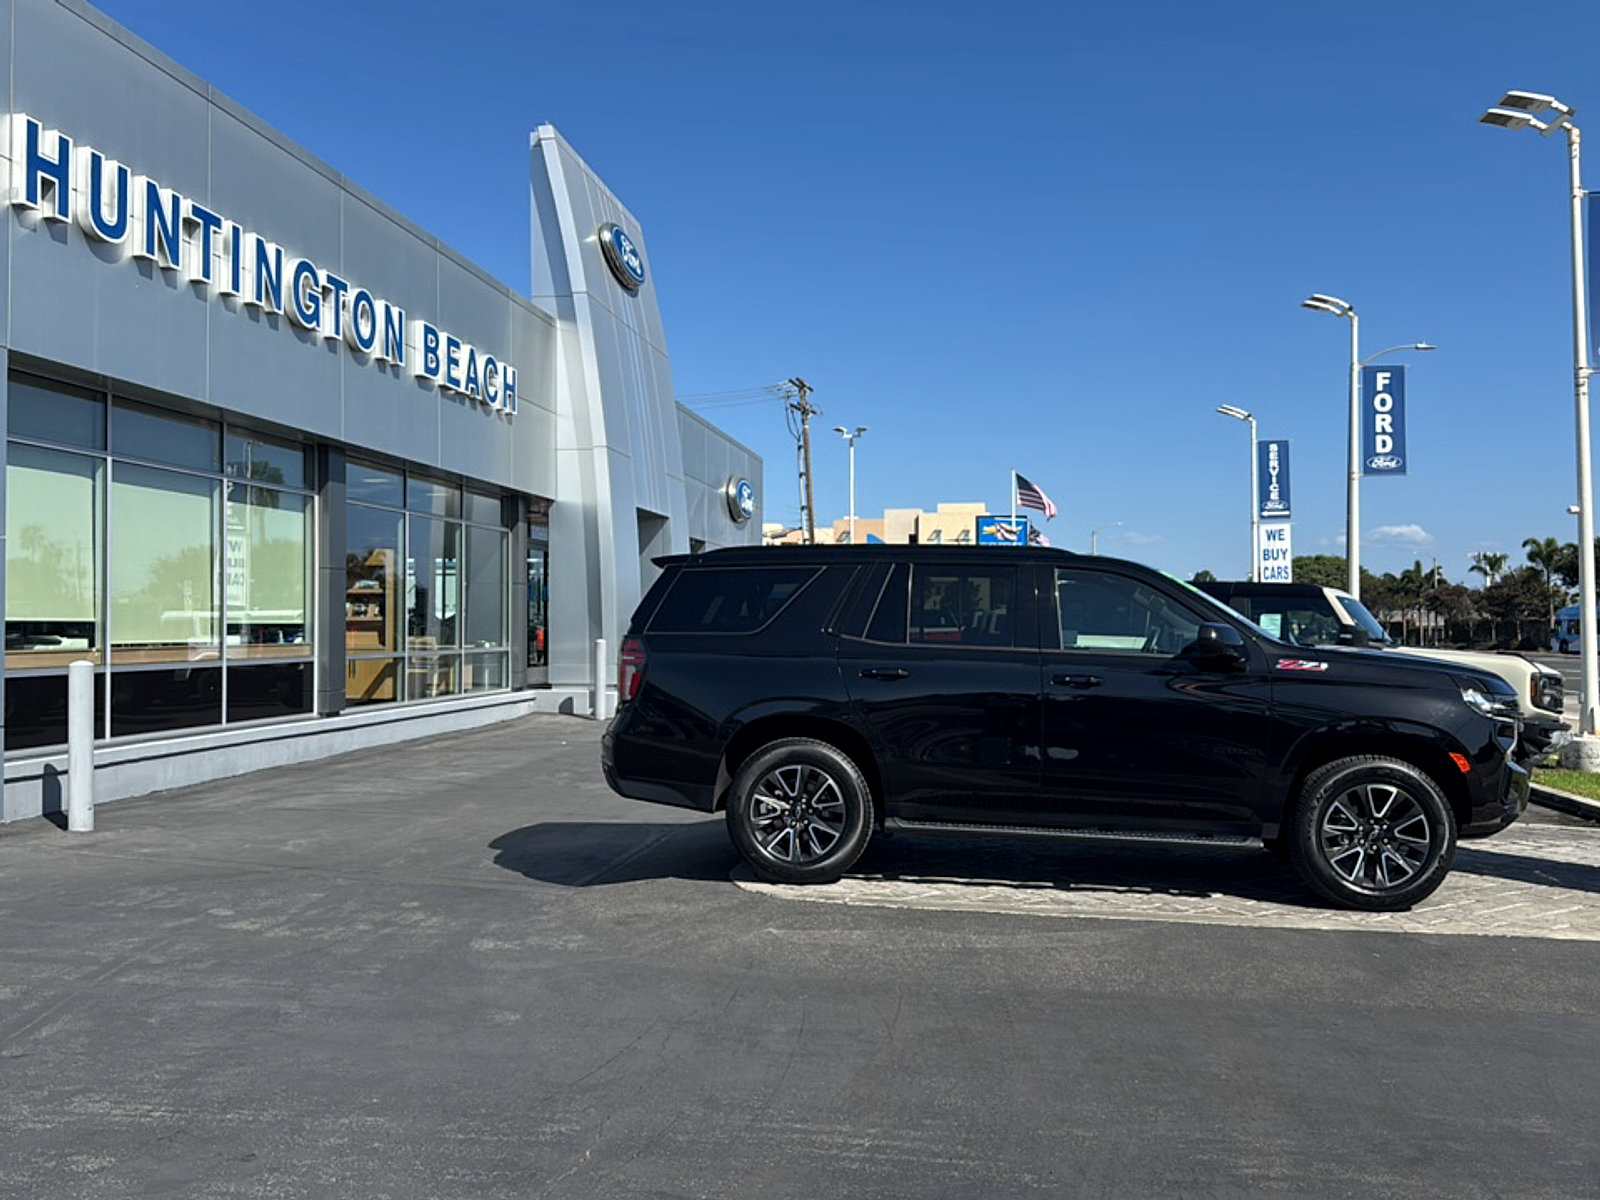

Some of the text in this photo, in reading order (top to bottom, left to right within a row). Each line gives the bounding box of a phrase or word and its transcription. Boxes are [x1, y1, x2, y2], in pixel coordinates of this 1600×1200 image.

[17, 114, 518, 415] HUNTINGTON BEACH
[1373, 371, 1394, 454] FORD
[1268, 443, 1280, 501] SERVICE
[1265, 528, 1286, 541] WE
[1263, 548, 1289, 561] BUY
[1263, 565, 1290, 580] CARS
